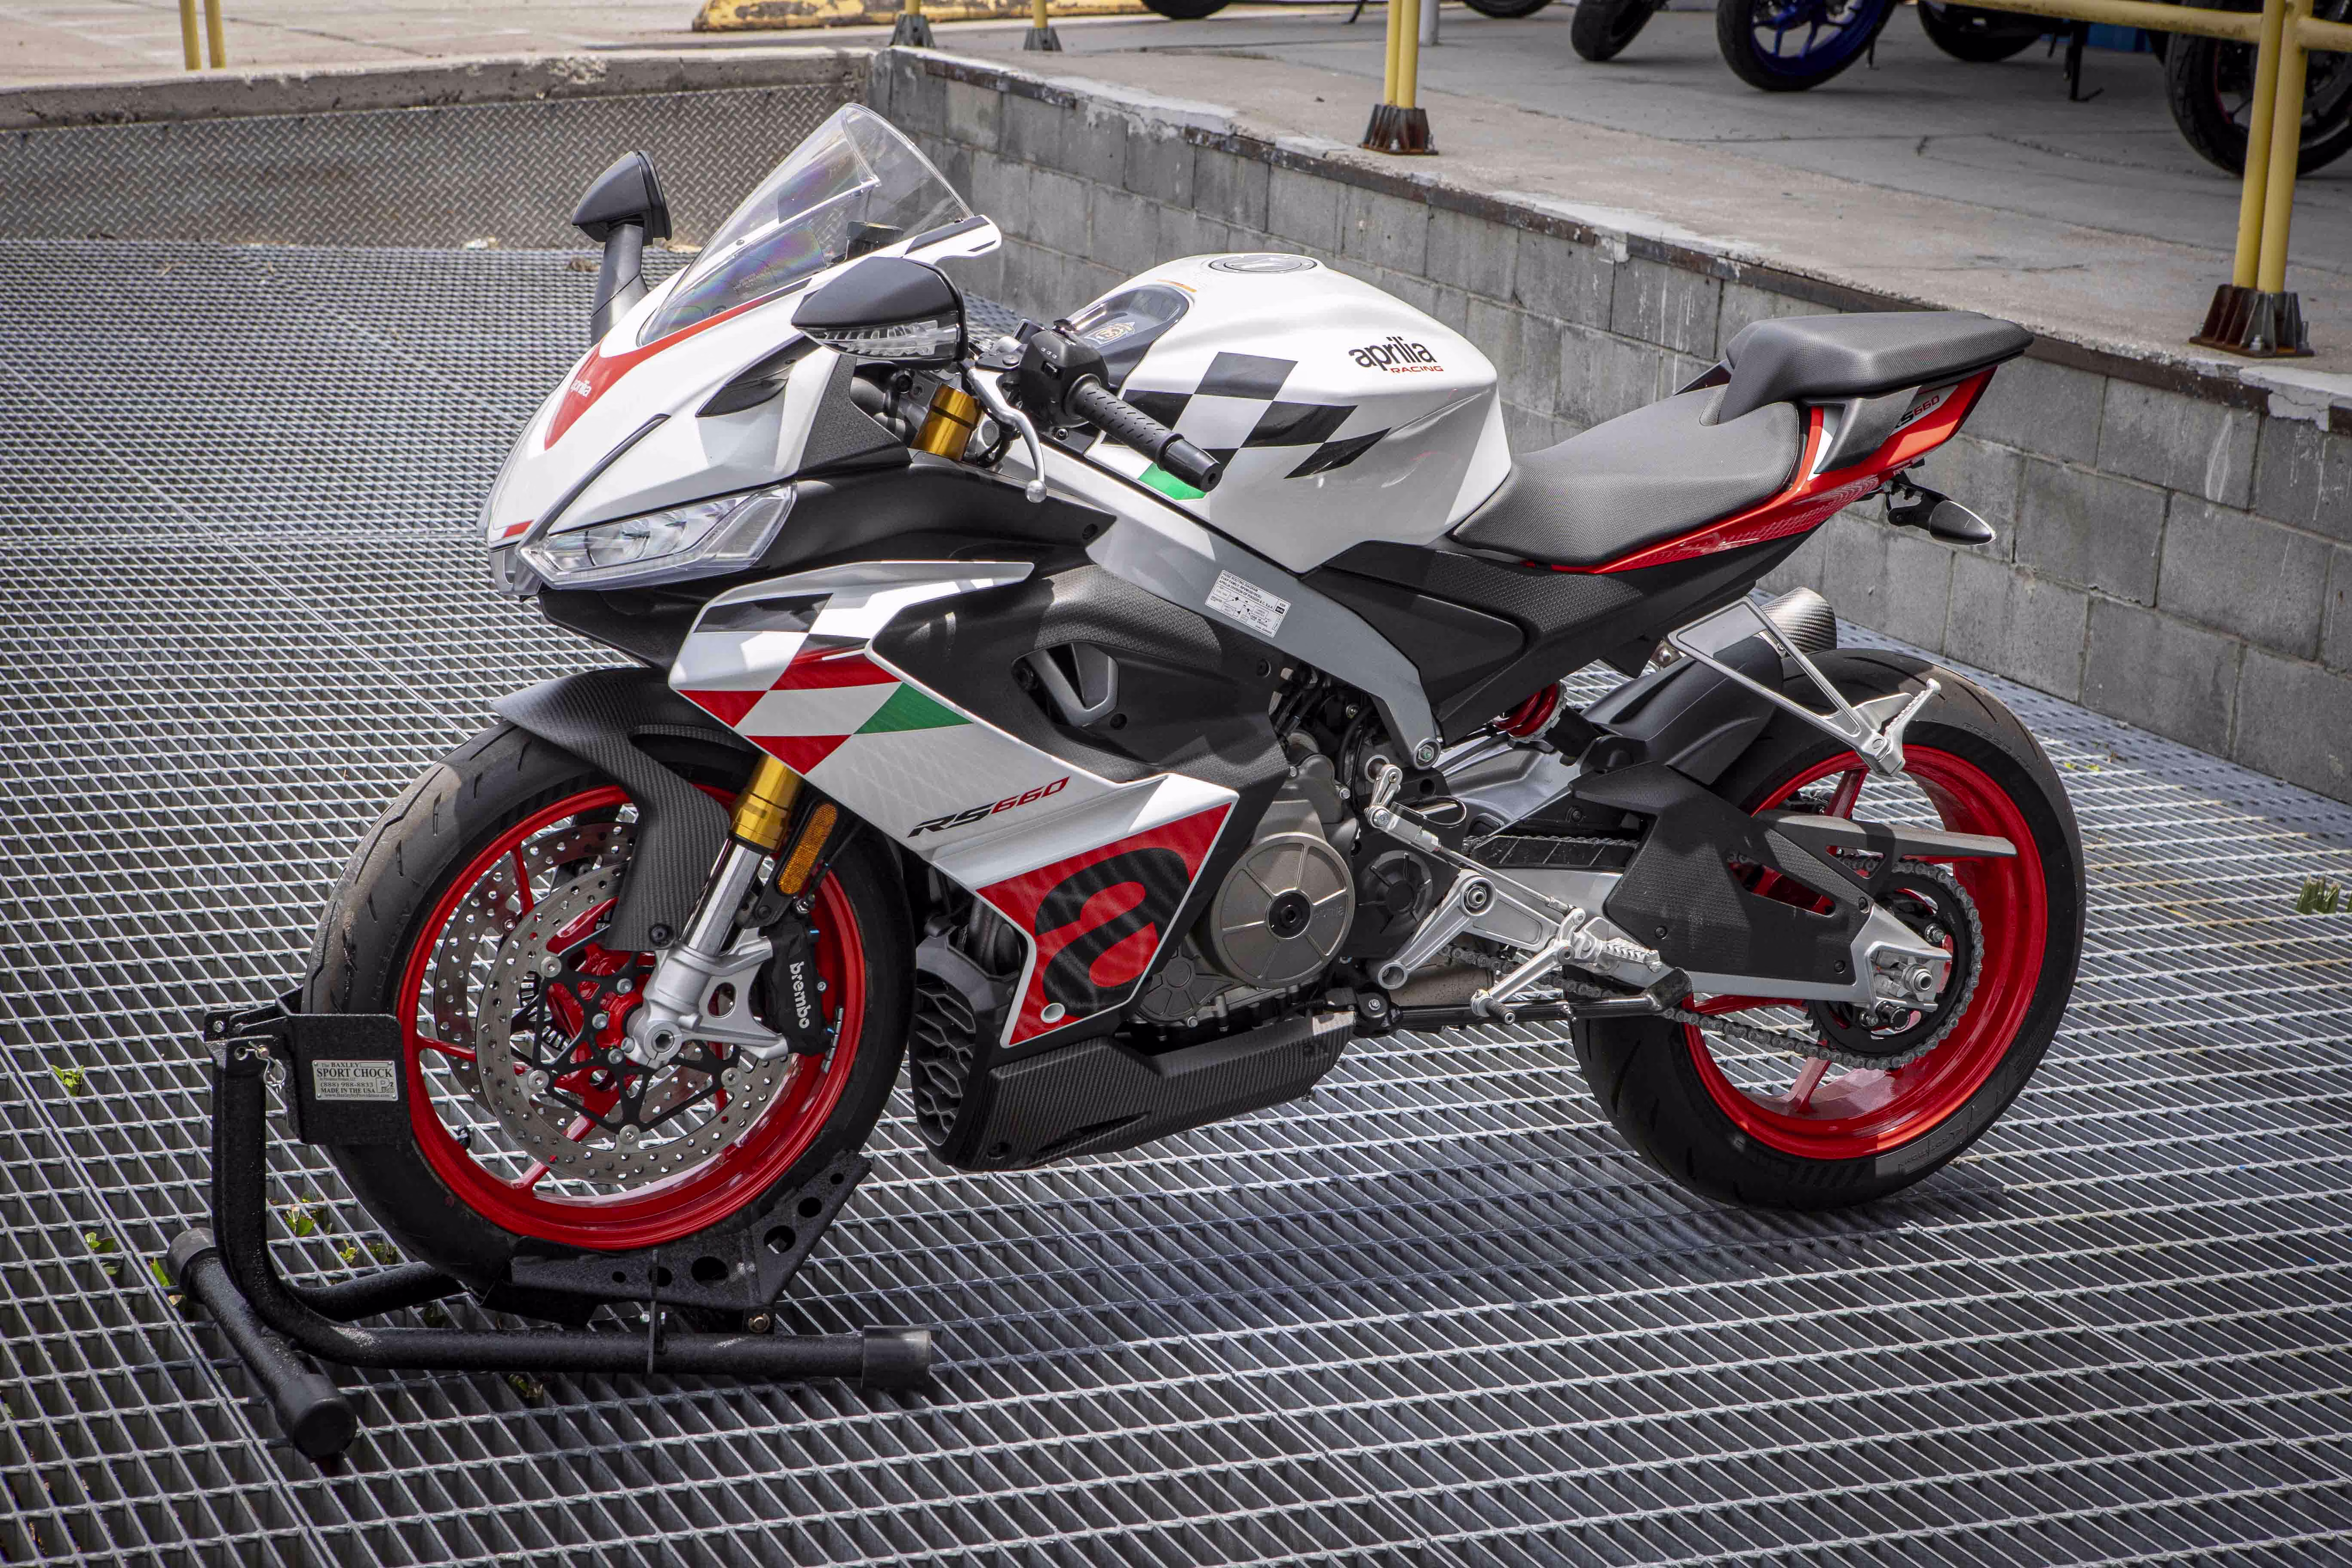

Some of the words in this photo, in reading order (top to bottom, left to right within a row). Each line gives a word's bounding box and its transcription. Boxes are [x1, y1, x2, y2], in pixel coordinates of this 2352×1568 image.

[1348, 337, 1437, 375] aprilia
[1231, 585, 1243, 594] DIVISION
[1232, 577, 1244, 585] ROUTING
[1245, 583, 1258, 592] DIAGRAM
[907, 776, 1070, 839] RS660
[790, 961, 812, 1029] brembo
[317, 1068, 351, 1077] SPORT
[353, 1068, 393, 1077] CHOCK
